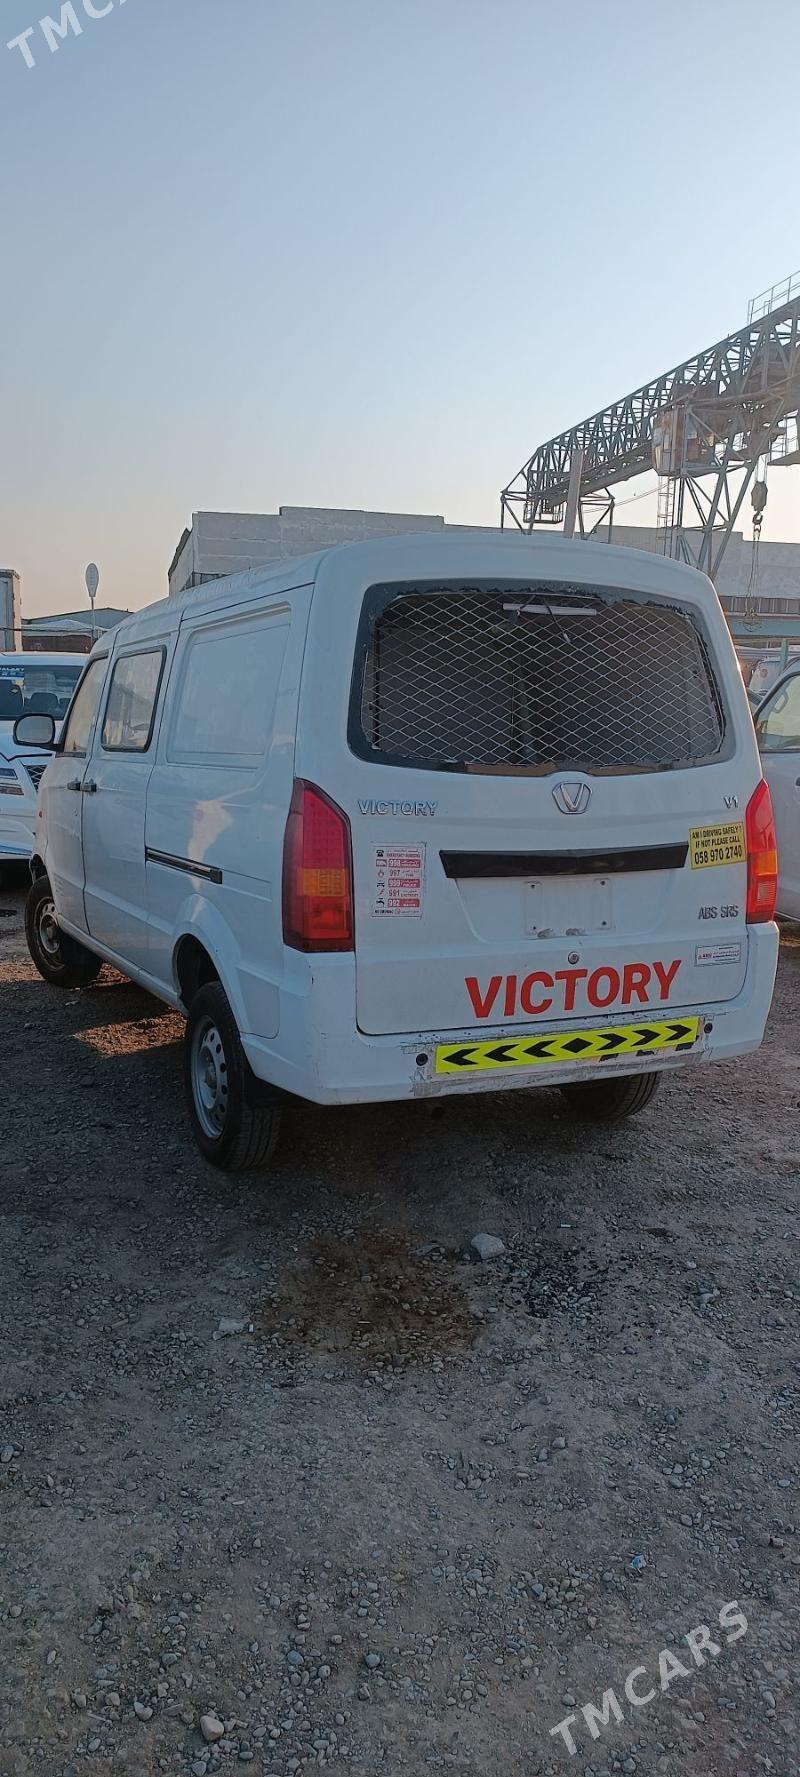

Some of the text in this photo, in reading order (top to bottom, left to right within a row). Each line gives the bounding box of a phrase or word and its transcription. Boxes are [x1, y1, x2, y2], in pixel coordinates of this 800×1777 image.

[358, 799, 438, 816] VICTORY
[723, 795, 739, 809] V1
[703, 828, 722, 838] DRIVING
[723, 826, 738, 835] SAFELY
[695, 835, 740, 848] IF NOT PLEASE CALL
[694, 844, 742, 864] 058 970 2740
[698, 904, 739, 920] ABS SRS
[465, 960, 682, 1018] VICTORY
